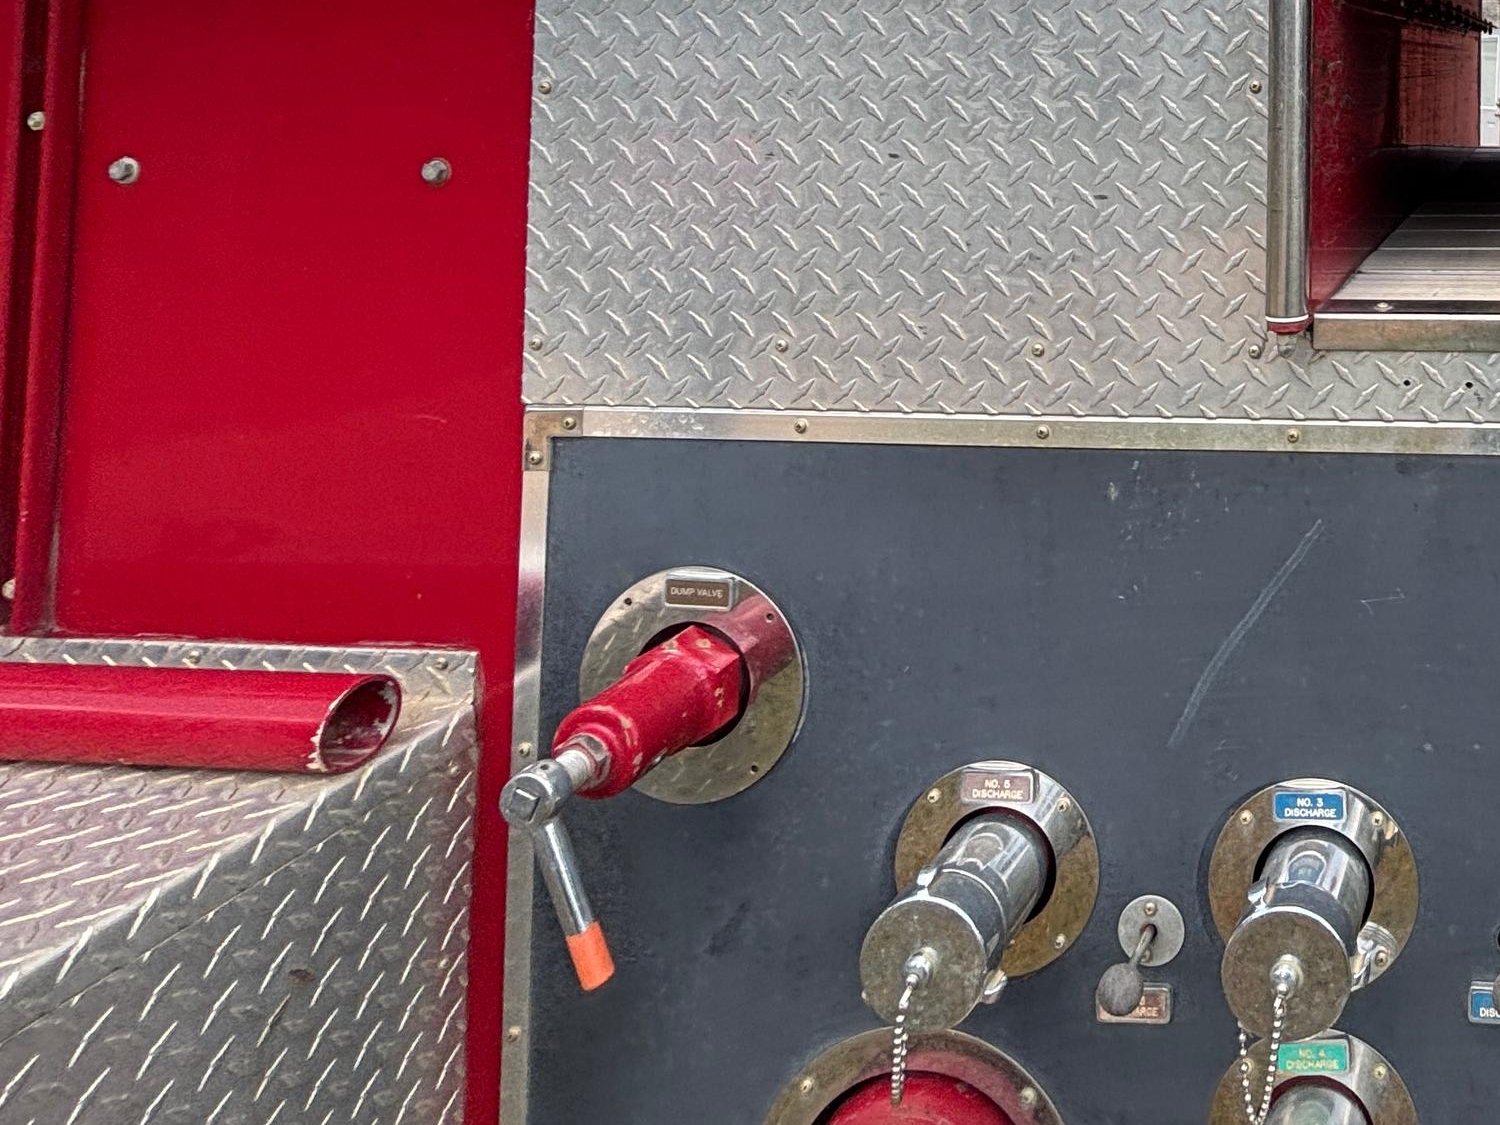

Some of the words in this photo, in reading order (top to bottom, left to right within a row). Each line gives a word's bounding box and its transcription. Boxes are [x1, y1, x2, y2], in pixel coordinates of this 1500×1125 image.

[670, 586, 696, 596] DUMP
[697, 588, 723, 598] VALVE
[984, 778, 1000, 789] NO.
[971, 788, 1024, 800] DISCHARGE
[1296, 797, 1313, 807] NO.
[1316, 797, 1324, 807] 3
[1284, 807, 1337, 818] DISCHARGE
[1286, 1059, 1339, 1070] DISCHARGE
